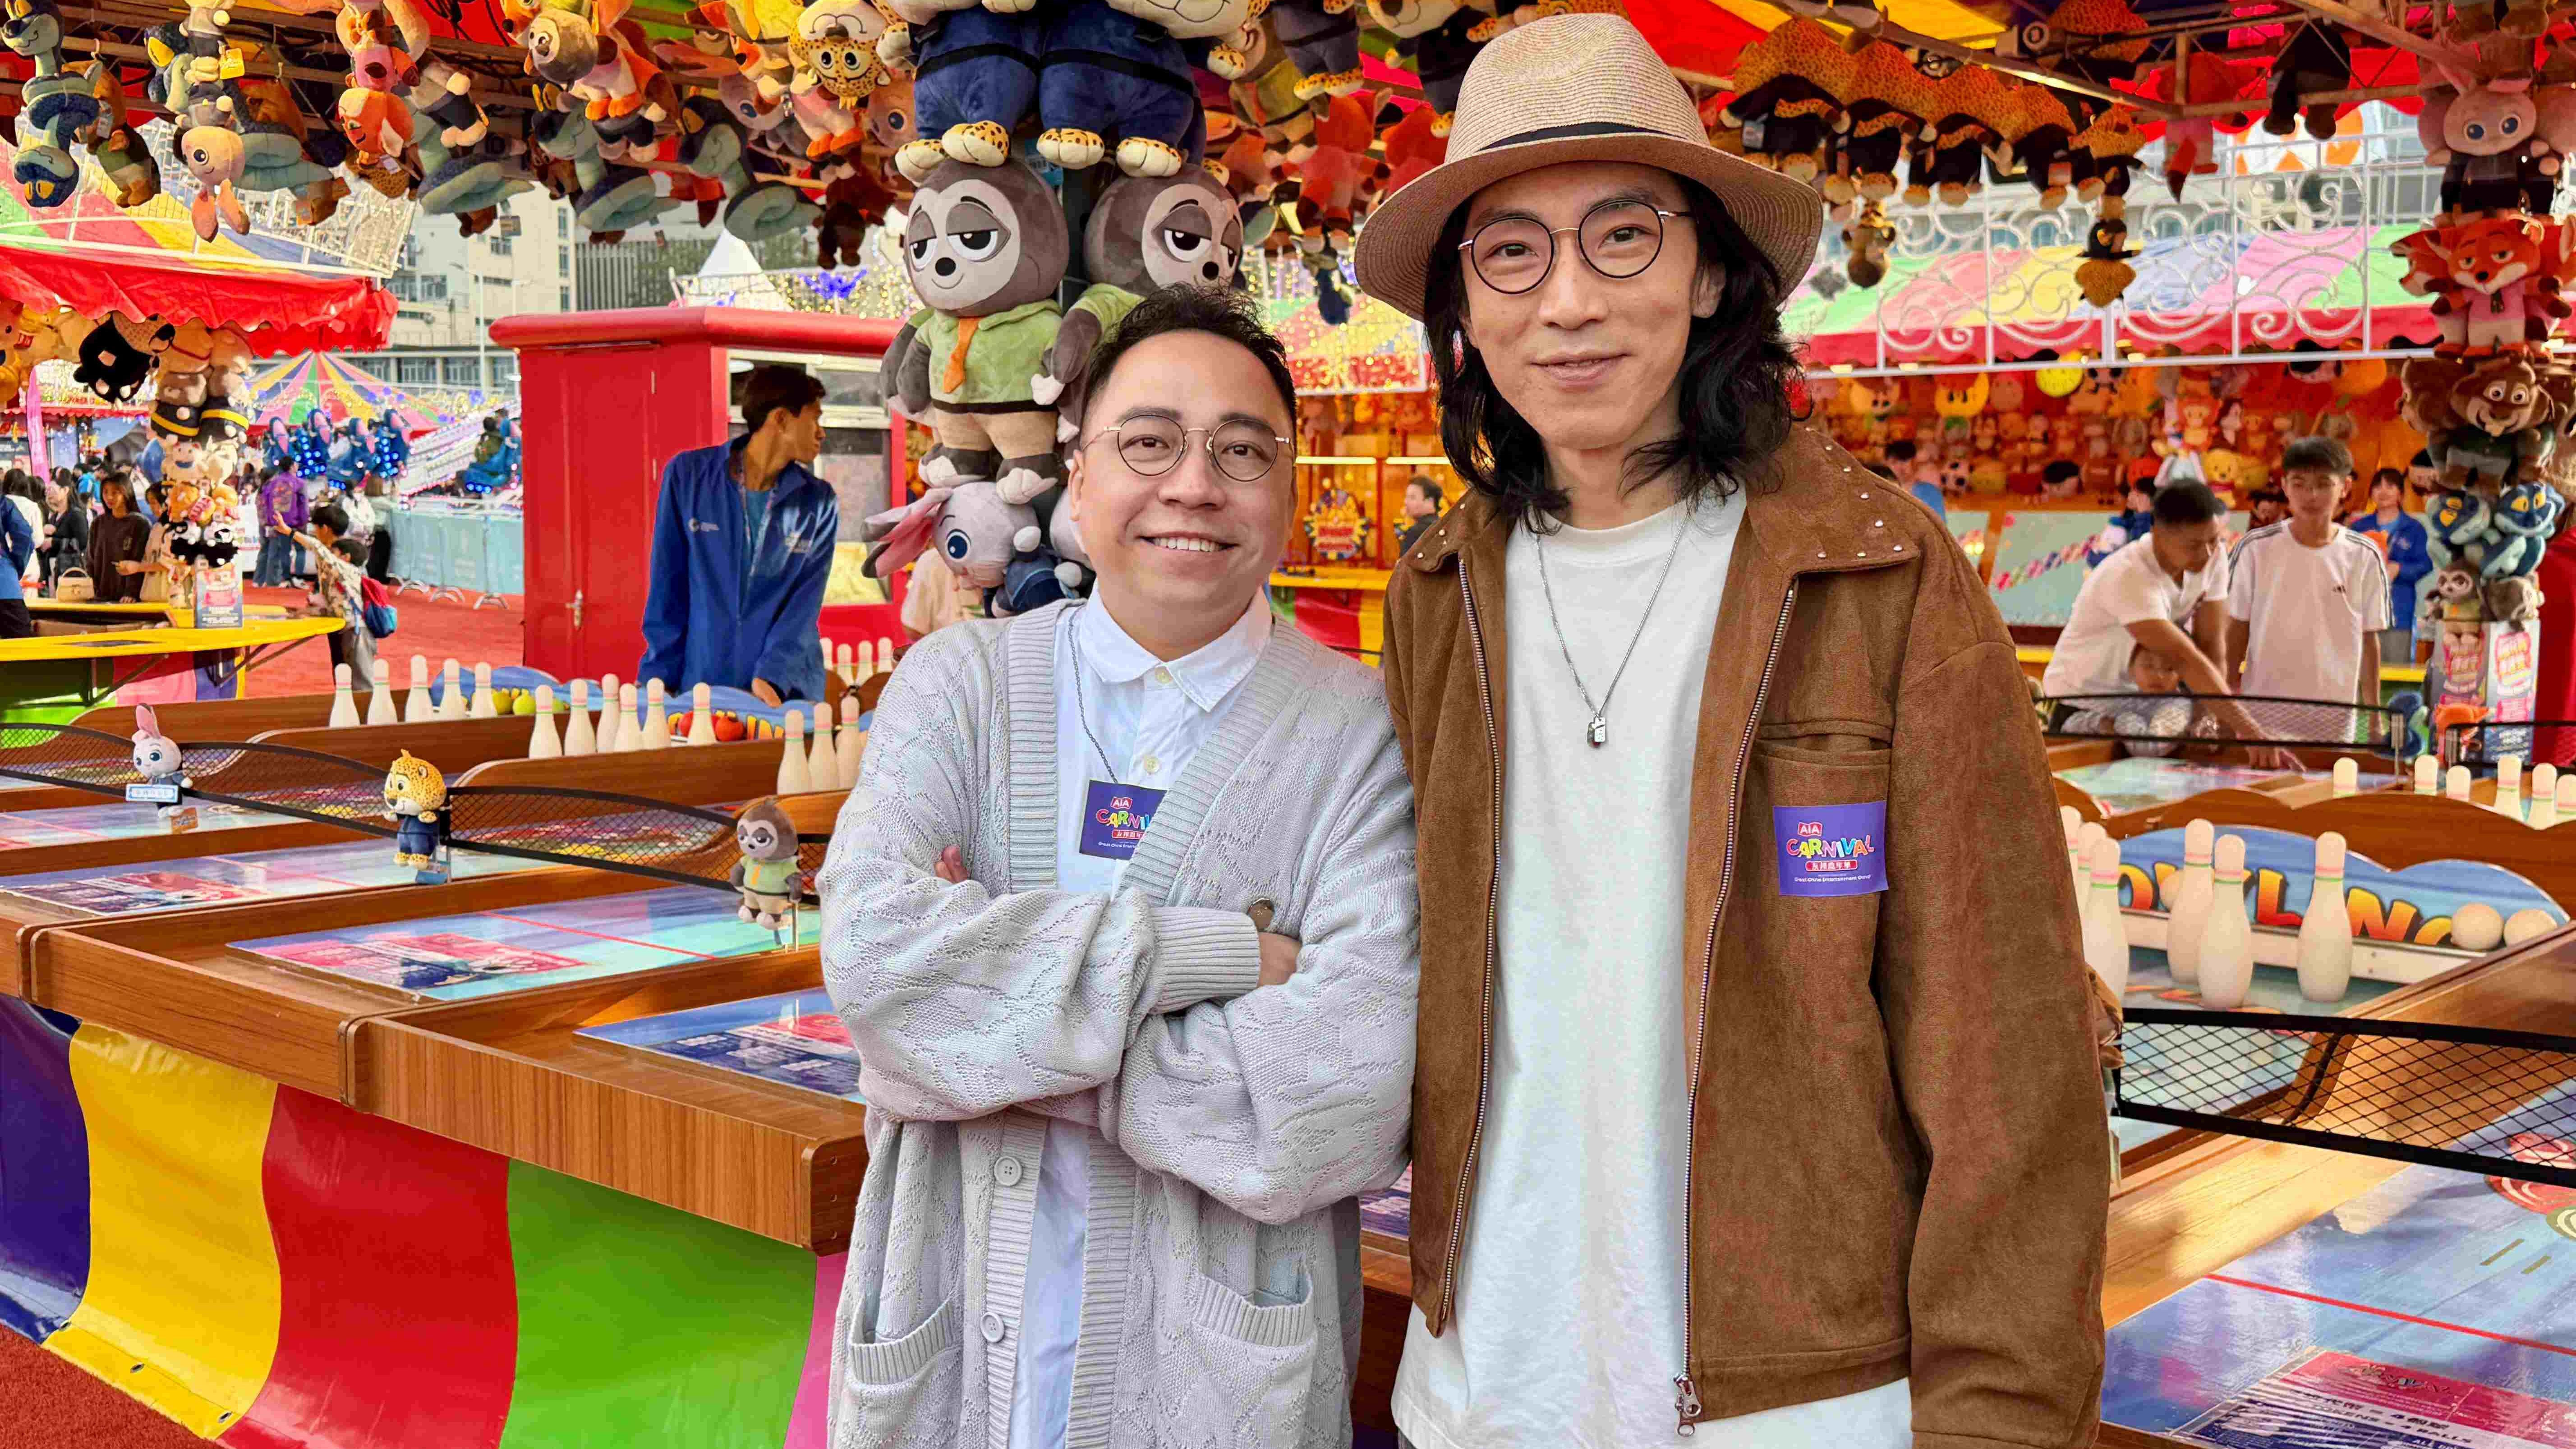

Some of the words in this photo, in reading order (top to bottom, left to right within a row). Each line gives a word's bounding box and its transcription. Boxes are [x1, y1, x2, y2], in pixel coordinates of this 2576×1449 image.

[1113, 799, 1129, 807] AIA
[1800, 825, 1820, 834] AIA
[1786, 835, 1874, 859] CARNIVAL
